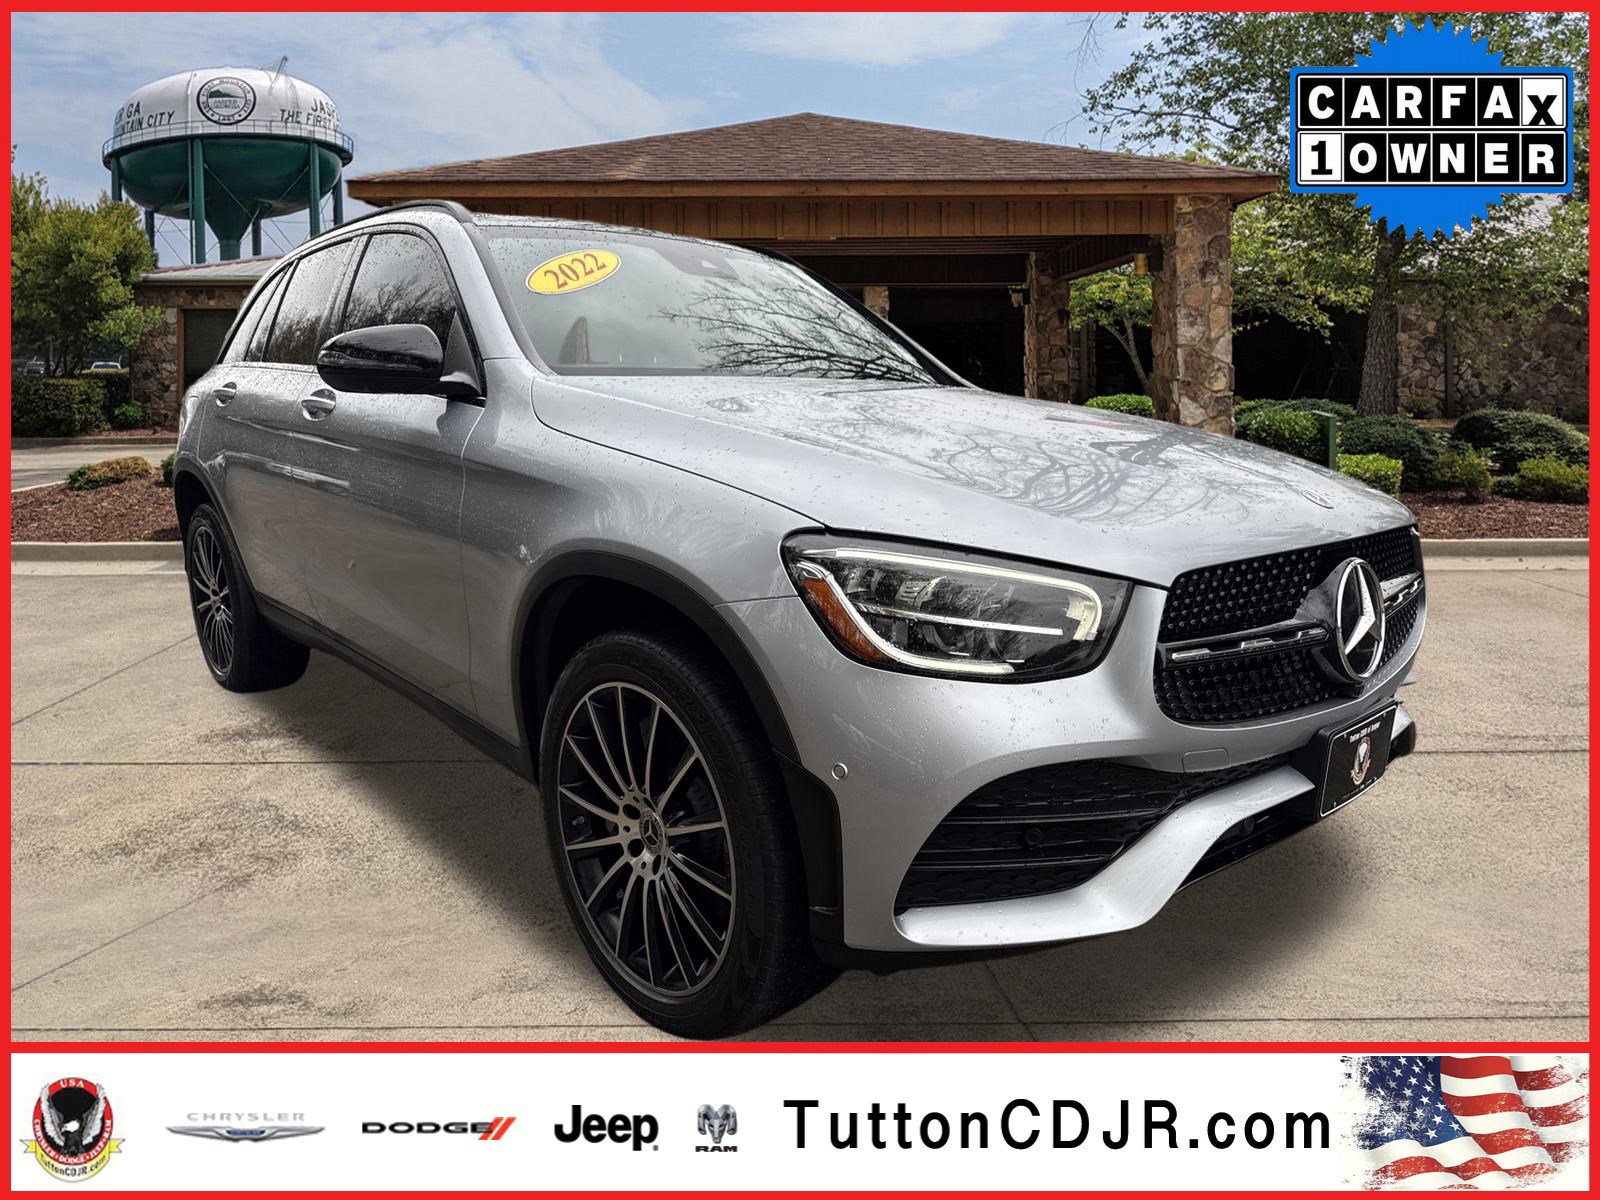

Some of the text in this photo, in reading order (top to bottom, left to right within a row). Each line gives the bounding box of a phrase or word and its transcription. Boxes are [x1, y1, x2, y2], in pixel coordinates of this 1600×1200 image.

[126, 100, 140, 119] GA
[147, 110, 175, 128] CITY
[280, 109, 302, 124] THE
[306, 112, 331, 129] FIRST
[544, 253, 607, 289] 2022
